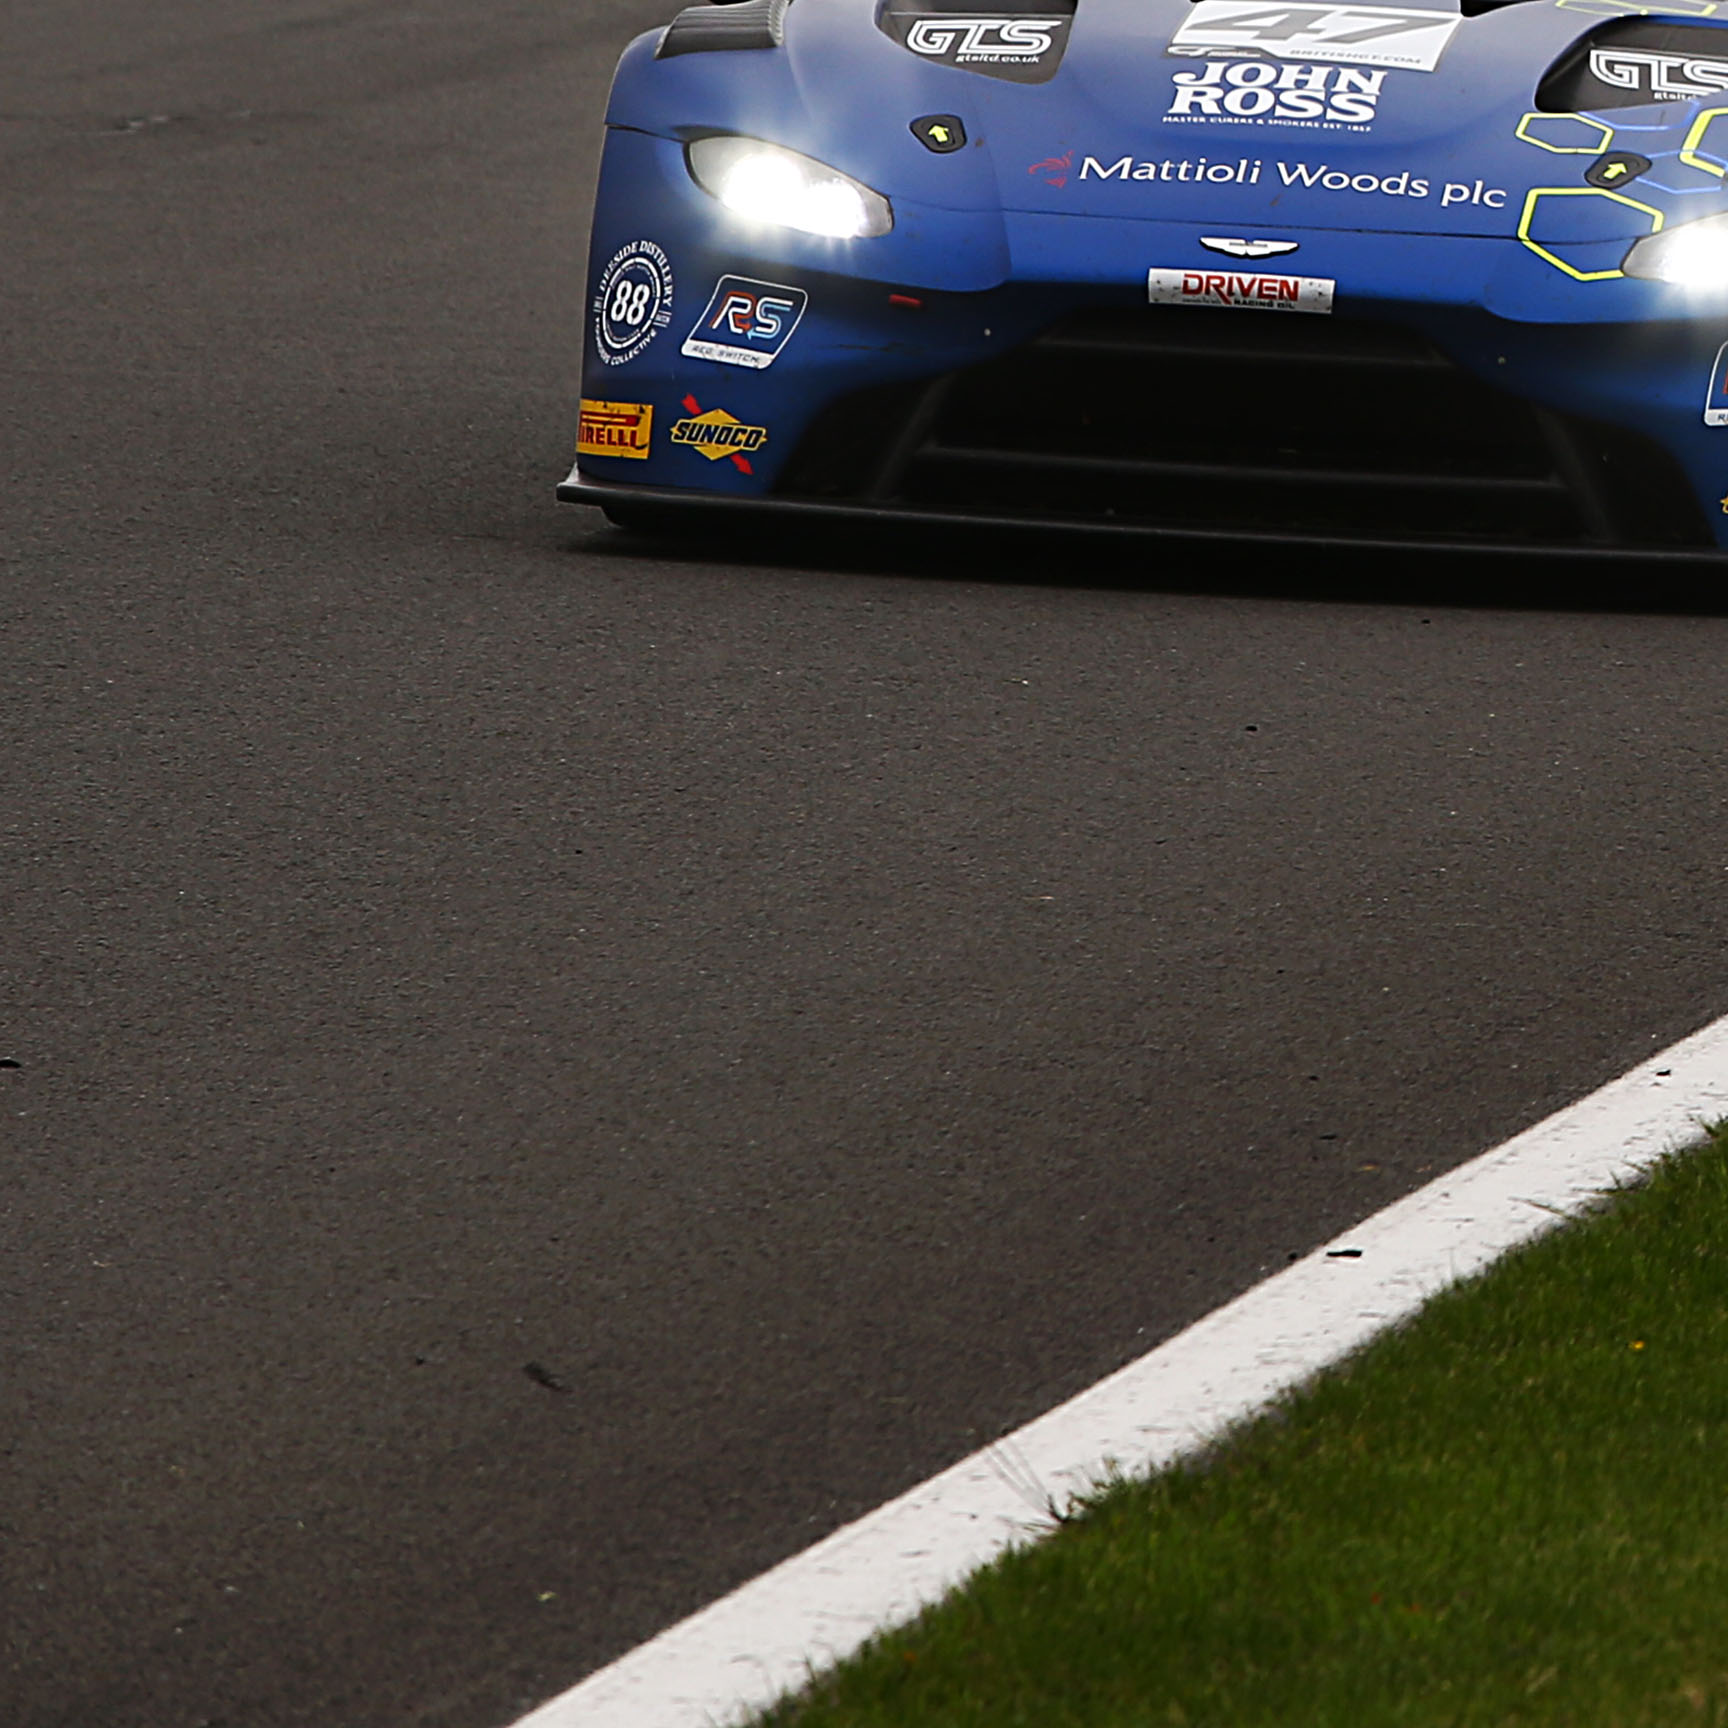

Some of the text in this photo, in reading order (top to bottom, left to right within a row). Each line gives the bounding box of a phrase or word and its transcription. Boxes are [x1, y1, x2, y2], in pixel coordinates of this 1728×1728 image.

[906, 19, 1063, 55] GTS
[1183, 7, 1459, 45] 47
[1171, 61, 1389, 96] JOHN
[1167, 85, 1377, 124] ROSS
[1078, 156, 1508, 209] Mattioli Woods plc
[610, 280, 651, 325] 88
[1181, 273, 1300, 306] DRIVEN
[708, 290, 794, 340] RS
[579, 411, 643, 448] IRELLI
[673, 421, 765, 449] SUNOCO
